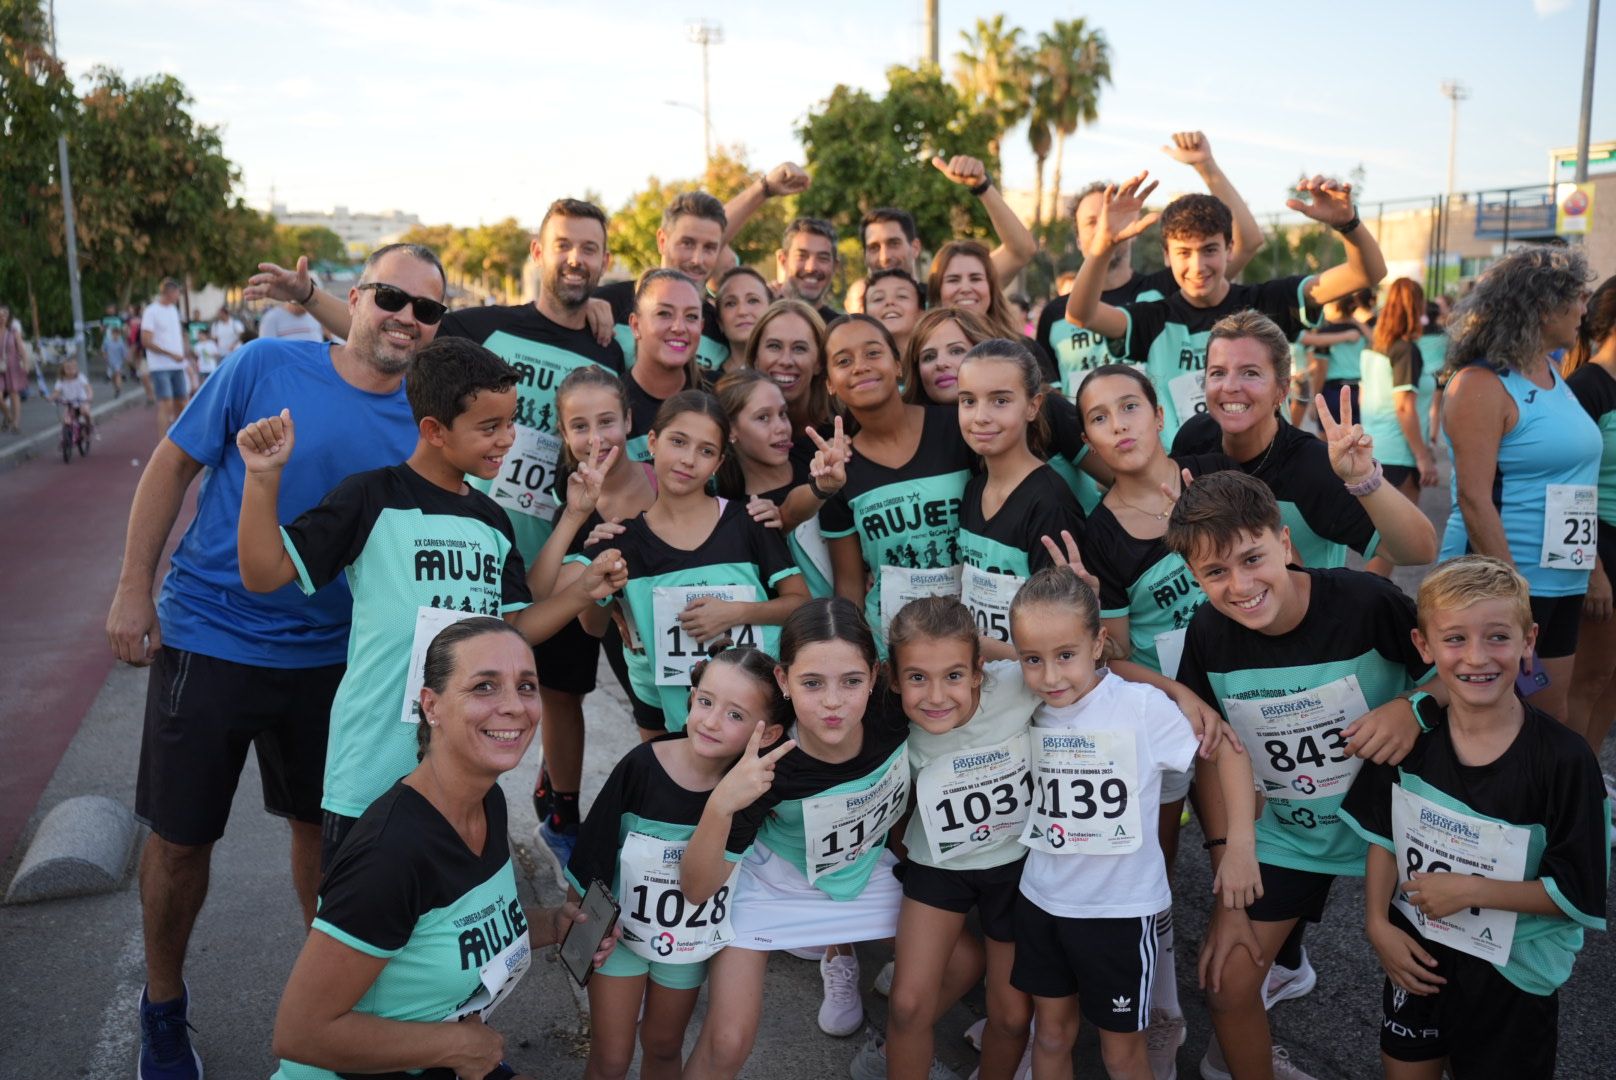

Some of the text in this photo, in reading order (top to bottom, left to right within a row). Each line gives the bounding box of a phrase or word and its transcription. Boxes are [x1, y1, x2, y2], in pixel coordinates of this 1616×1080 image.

[1260, 687, 1287, 698] CÓRDOBA
[1265, 727, 1349, 772] 843
[936, 771, 1035, 832] 1031
[1037, 776, 1128, 820] 1139
[630, 885, 730, 928] 1028
